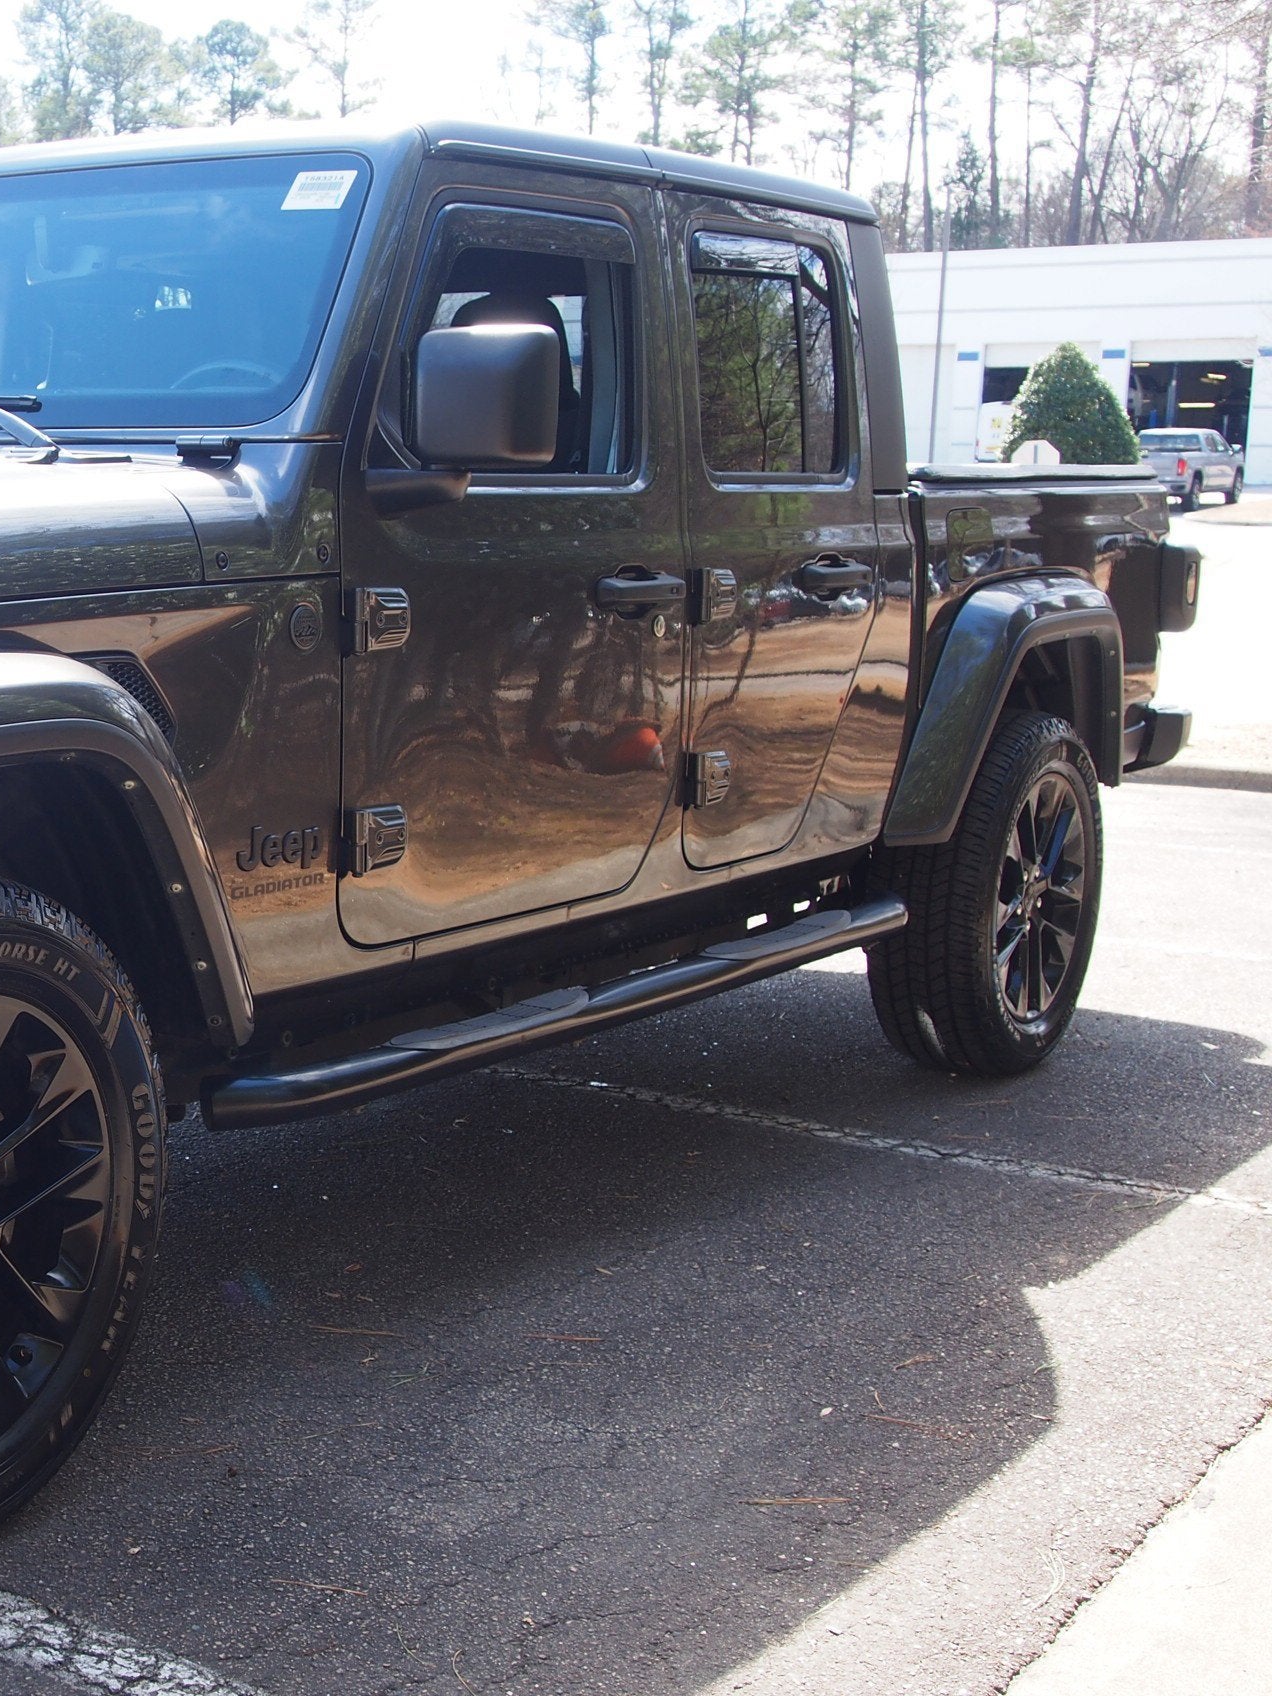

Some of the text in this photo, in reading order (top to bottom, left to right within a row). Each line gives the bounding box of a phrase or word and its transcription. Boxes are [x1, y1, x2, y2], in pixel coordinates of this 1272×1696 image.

[236, 825, 322, 871] Jeep
[230, 872, 327, 900] GLADIATOR
[52, 956, 81, 982] HT
